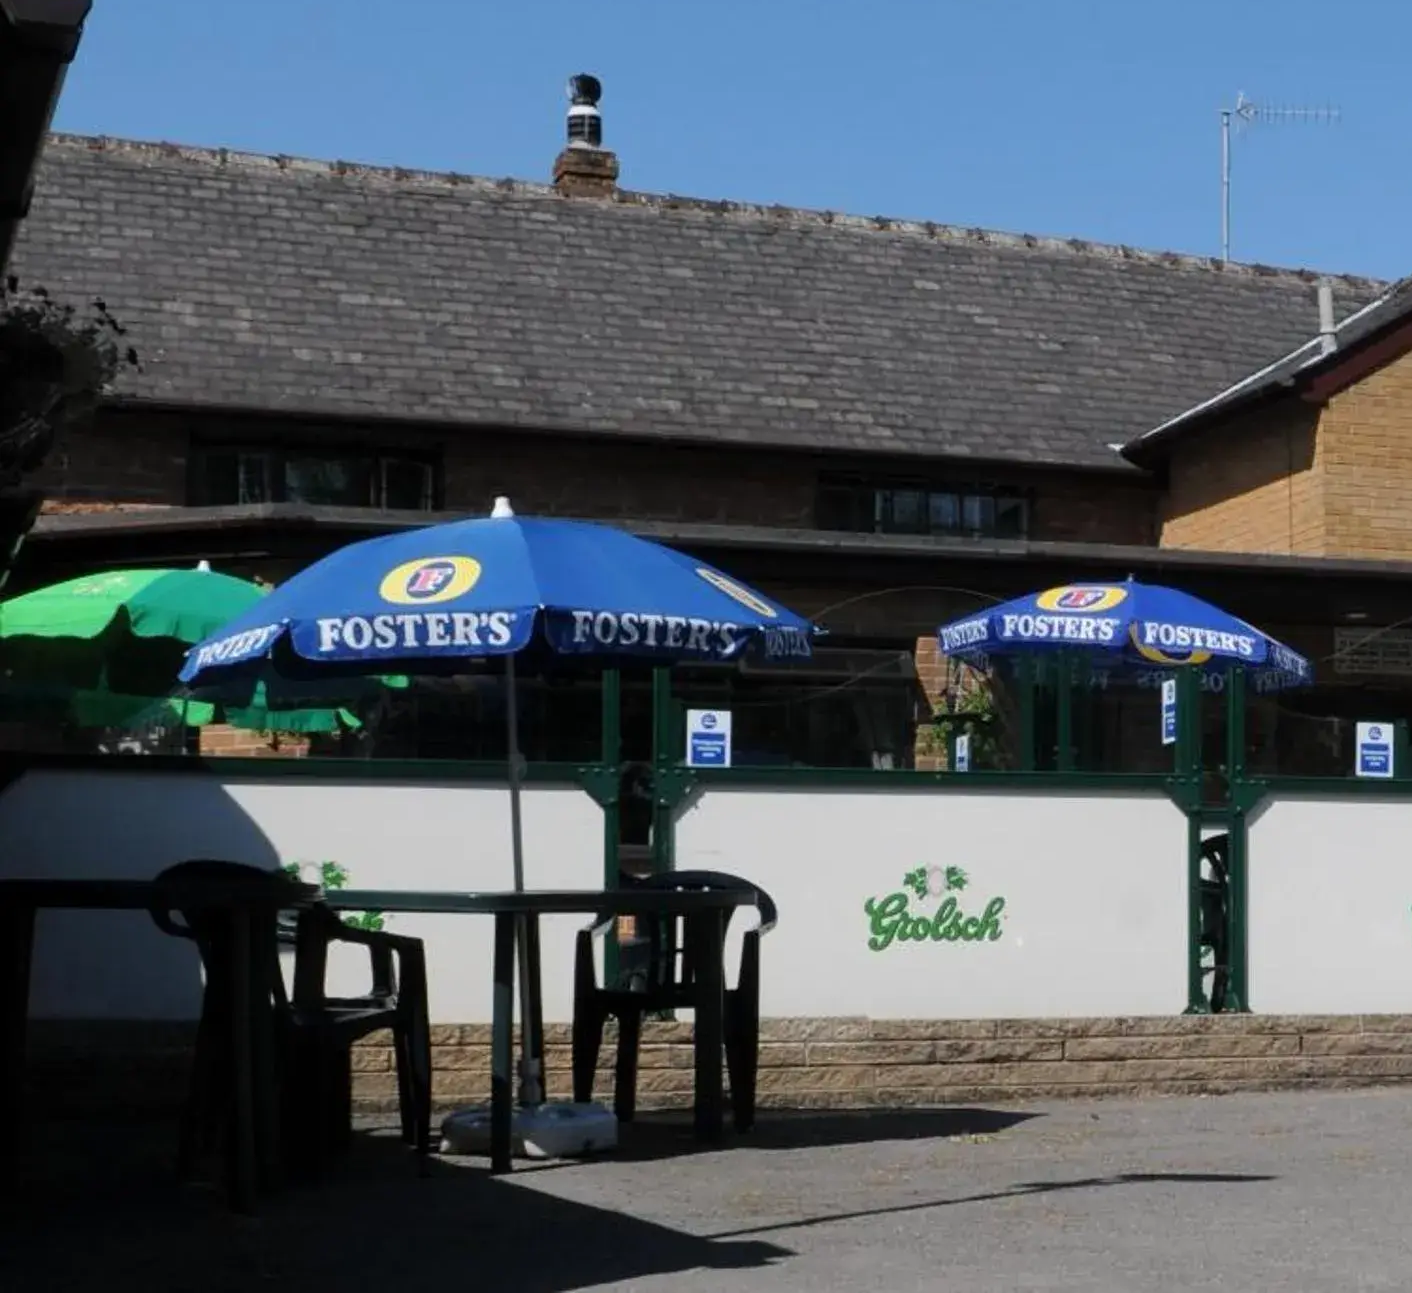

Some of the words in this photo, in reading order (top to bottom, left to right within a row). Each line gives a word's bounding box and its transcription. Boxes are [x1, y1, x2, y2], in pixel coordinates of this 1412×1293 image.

[317, 612, 512, 652] FOSTER'S
[572, 610, 738, 655] FOSTER'S
[1002, 615, 1115, 641] FOSTER'S
[1143, 622, 1253, 656] FOSTER'S
[864, 893, 1005, 951] Grolsch
